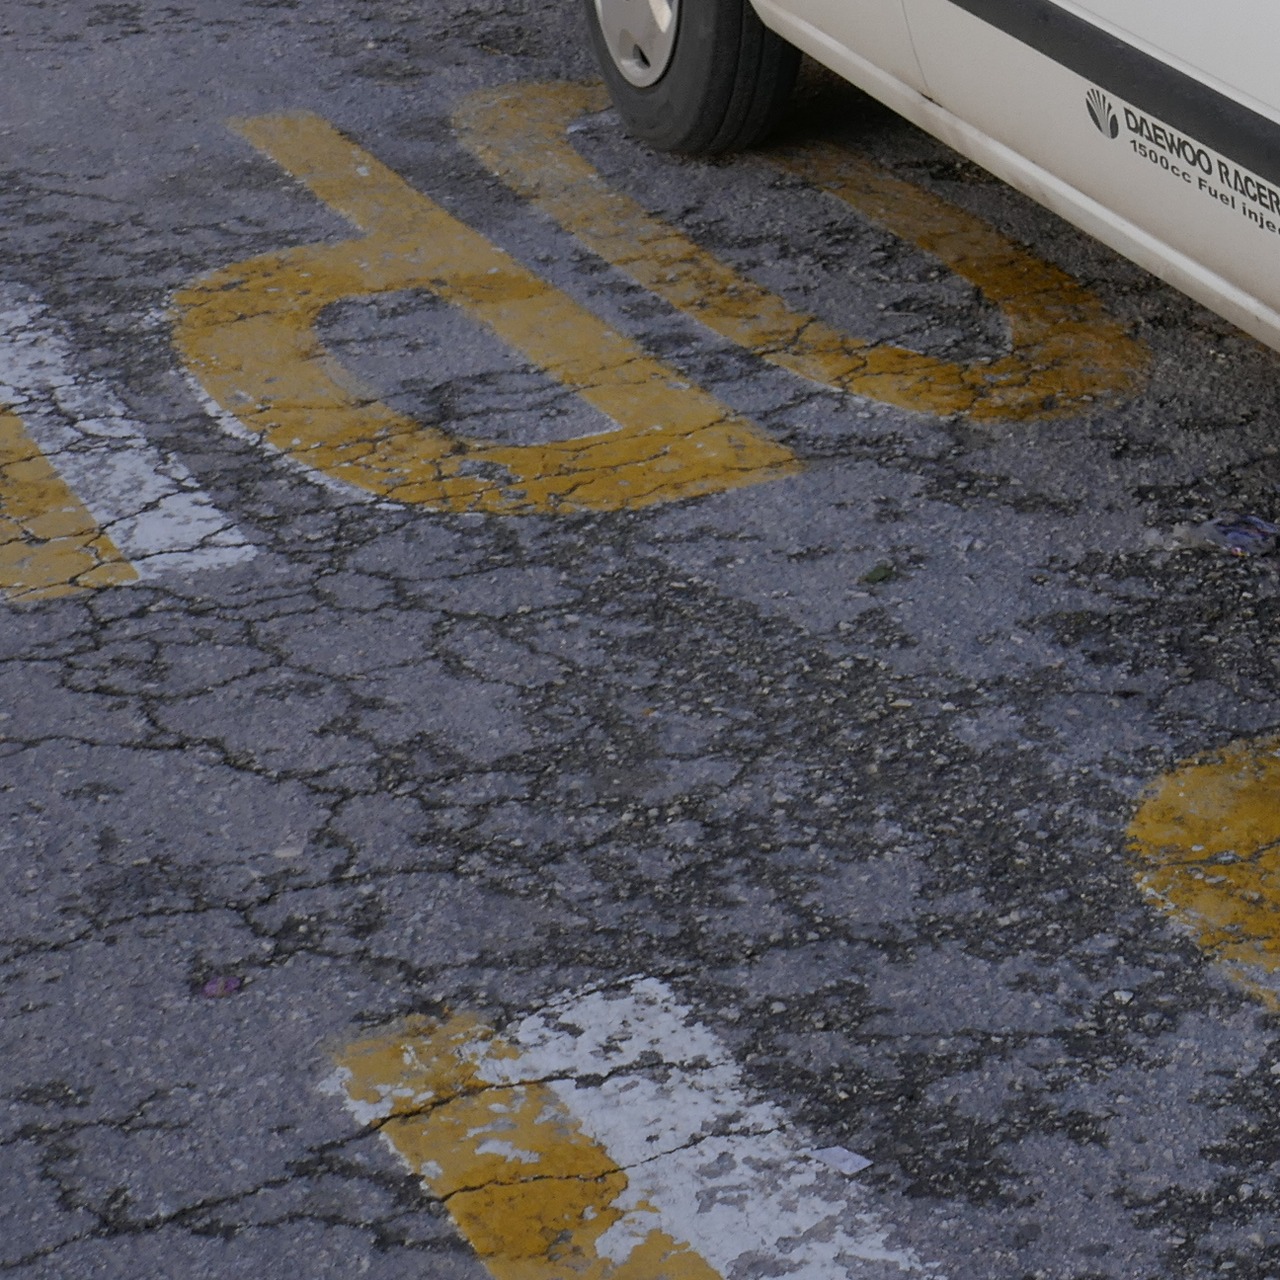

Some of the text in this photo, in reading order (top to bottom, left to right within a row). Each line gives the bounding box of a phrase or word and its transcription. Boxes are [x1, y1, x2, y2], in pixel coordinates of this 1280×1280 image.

[1123, 106, 1213, 175] DAEWOO
[1129, 139, 1192, 183] 1500cc
[1197, 177, 1236, 210] Fuel
